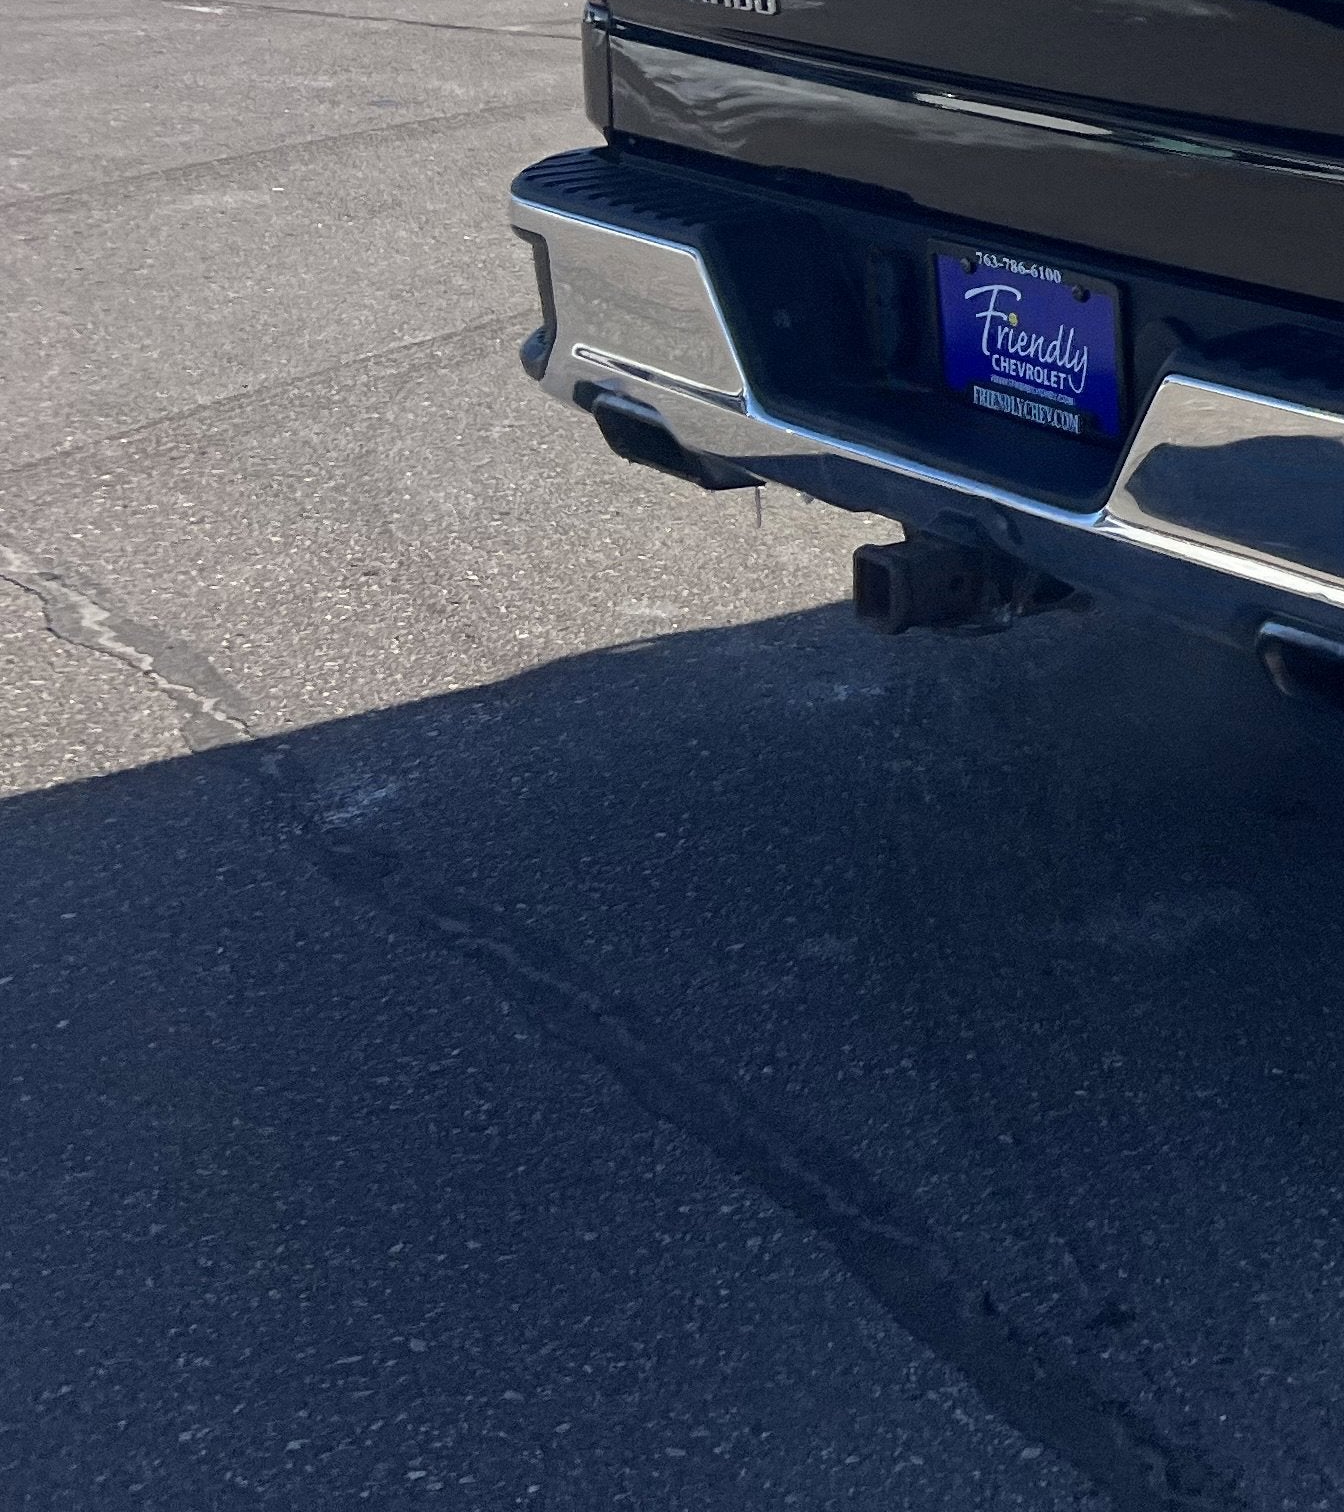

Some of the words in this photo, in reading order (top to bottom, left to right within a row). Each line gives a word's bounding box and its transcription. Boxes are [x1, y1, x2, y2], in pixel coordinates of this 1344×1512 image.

[975, 251, 1062, 284] 763-786-6100
[964, 284, 1088, 394] Friendly
[991, 354, 1068, 390] CHEVROLET
[973, 385, 1081, 434] FRIENDLYCHEV.COM
